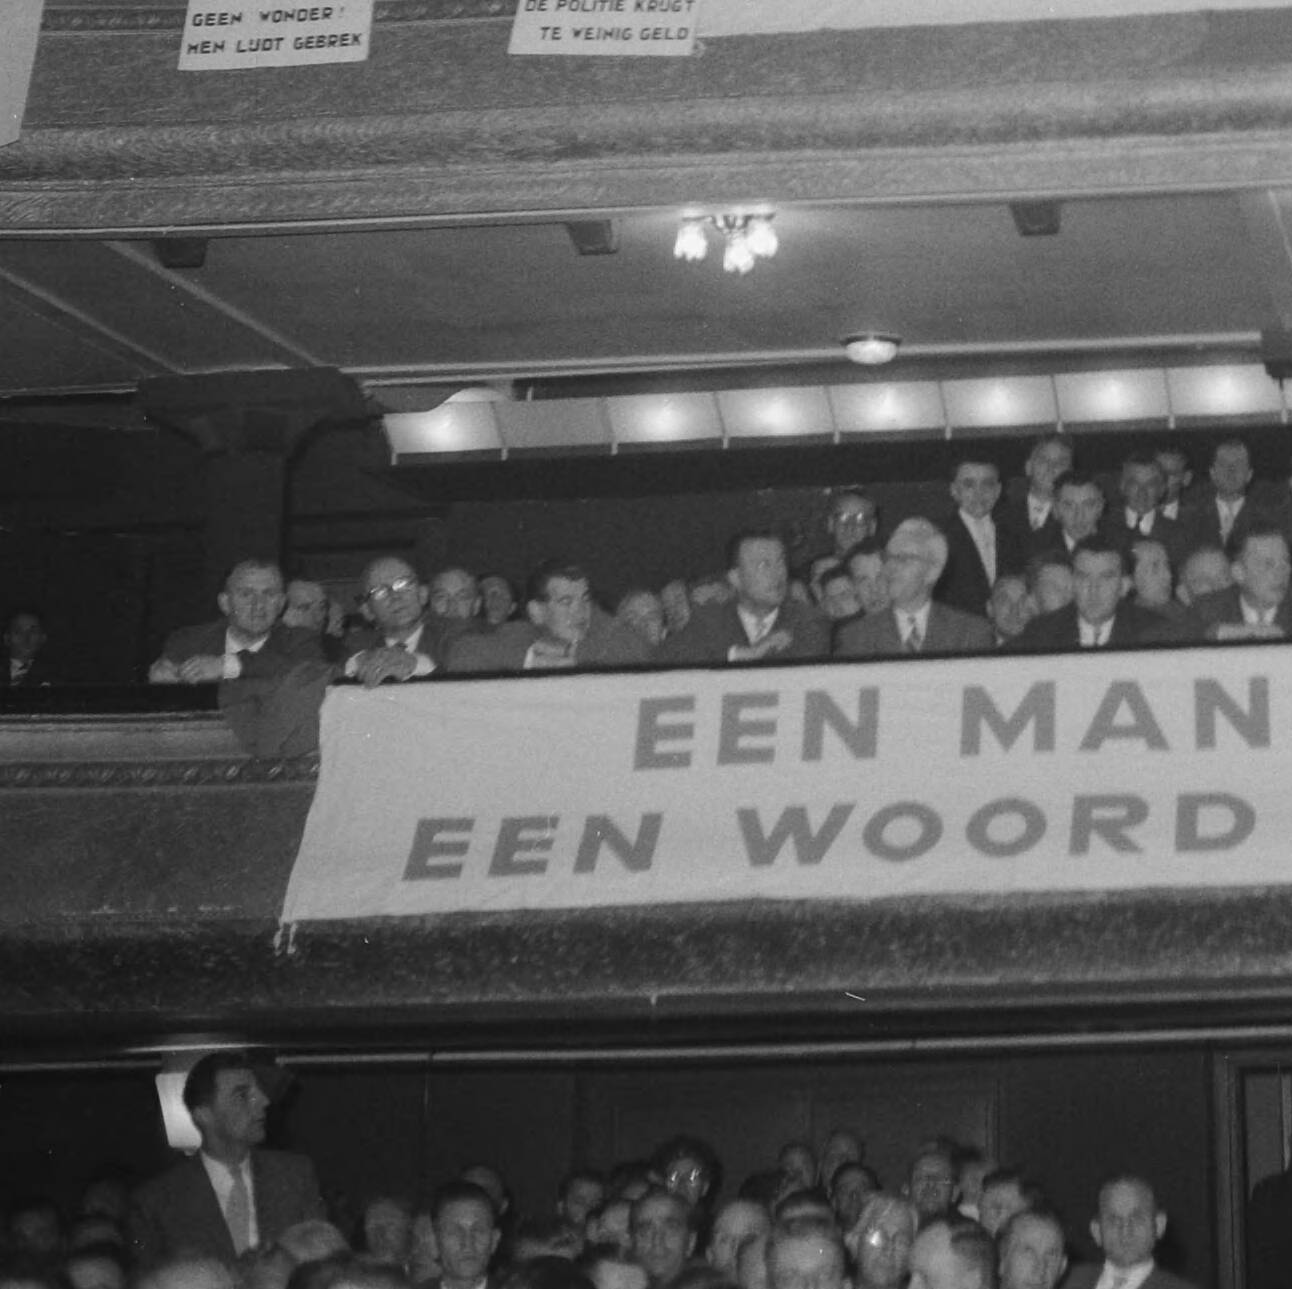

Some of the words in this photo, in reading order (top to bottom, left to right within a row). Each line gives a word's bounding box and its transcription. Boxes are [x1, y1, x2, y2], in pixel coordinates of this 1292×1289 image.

[192, 12, 242, 27] GEEN
[187, 40, 225, 54] MEN
[294, 33, 362, 50] GEBREK
[540, 26, 562, 40] TE
[640, 27, 689, 40] GELD
[633, 686, 881, 772] EEN
[959, 675, 1273, 759] MAN
[400, 811, 664, 883] EEN
[736, 790, 1258, 868] WOORD
